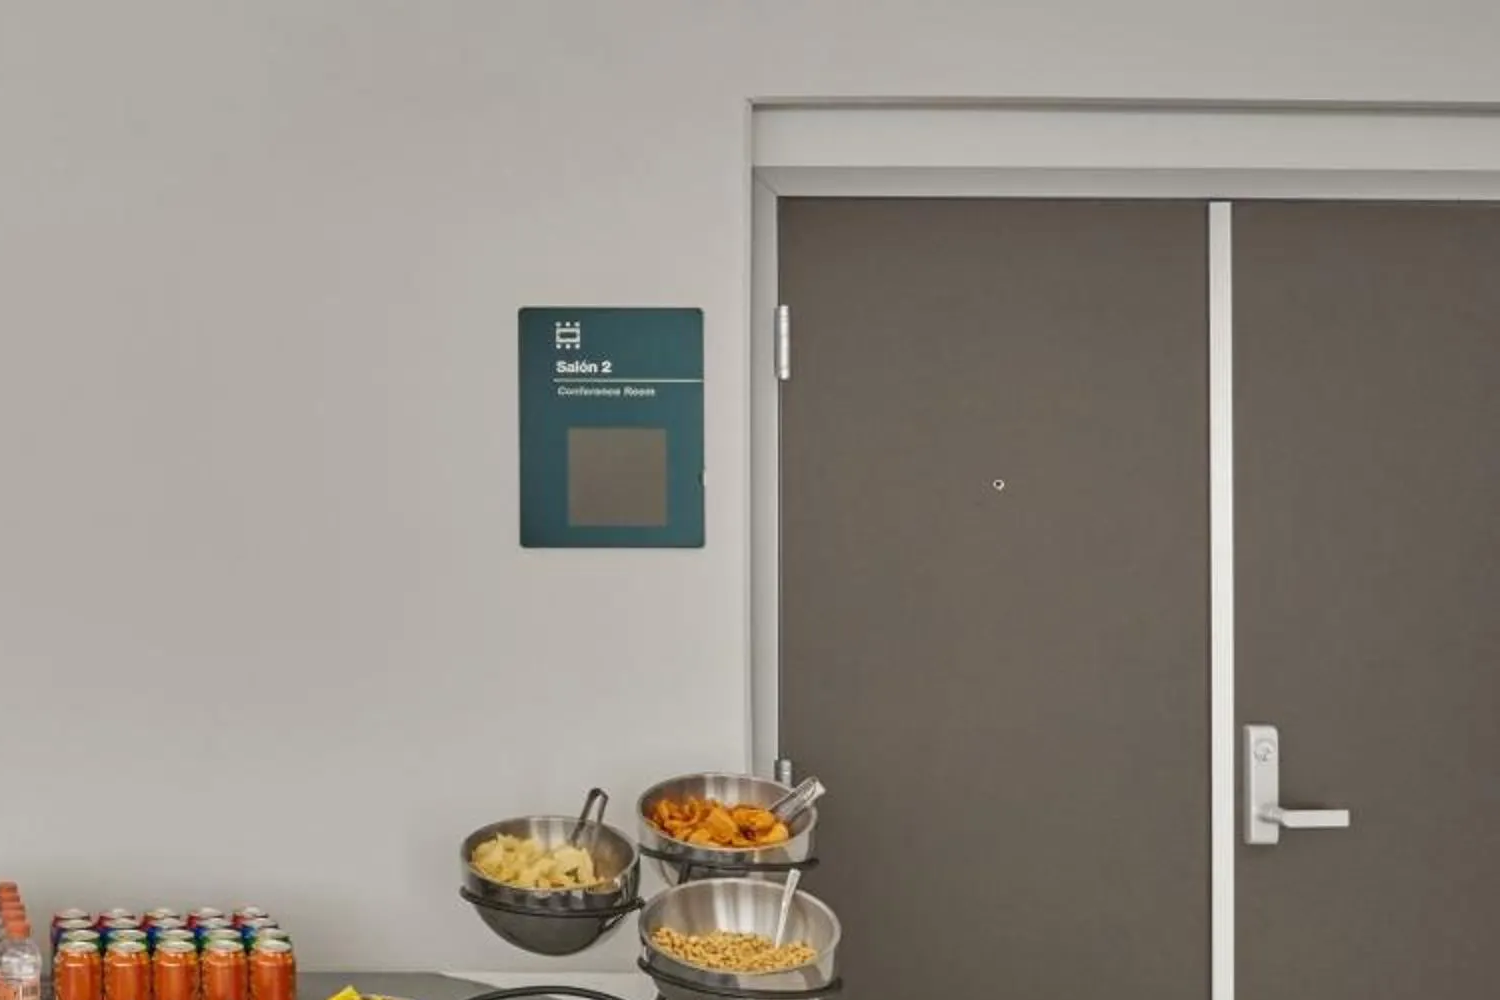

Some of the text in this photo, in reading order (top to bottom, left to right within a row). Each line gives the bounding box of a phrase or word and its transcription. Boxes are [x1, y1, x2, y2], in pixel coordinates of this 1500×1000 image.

[555, 359, 613, 373] Salón 2
[557, 386, 655, 396] Conference Room
